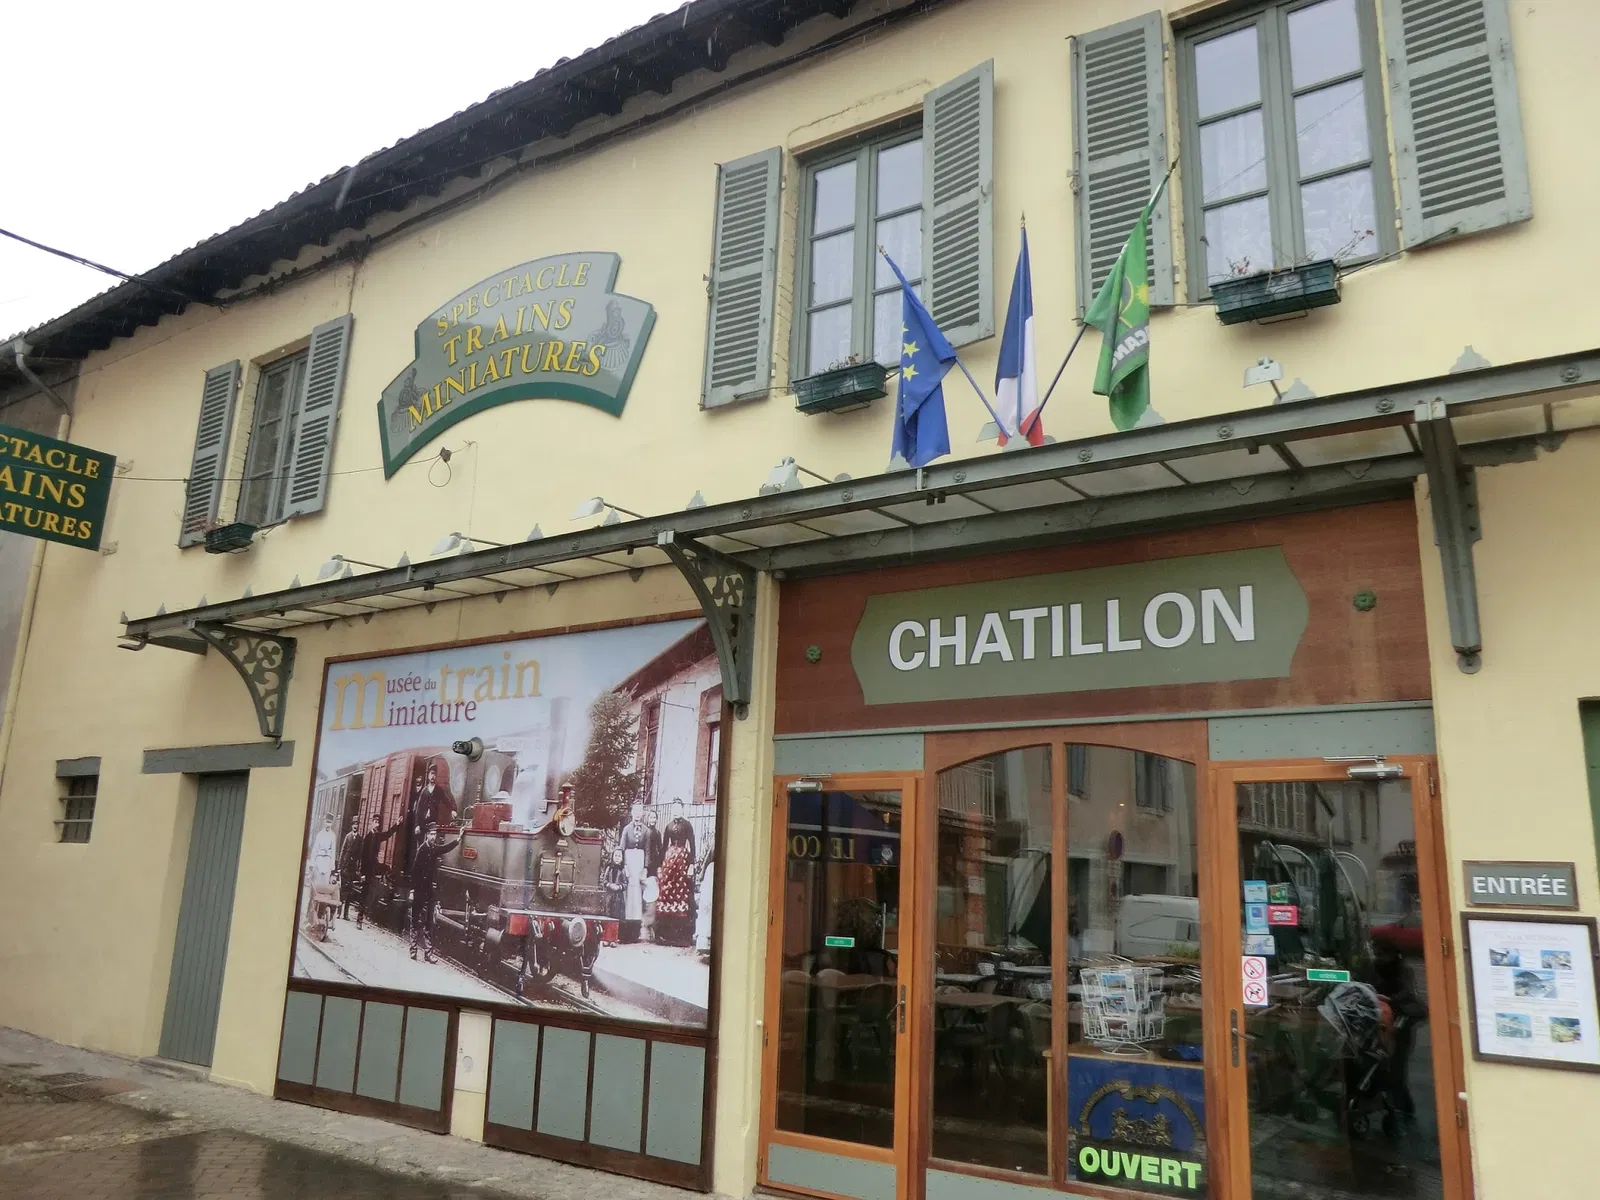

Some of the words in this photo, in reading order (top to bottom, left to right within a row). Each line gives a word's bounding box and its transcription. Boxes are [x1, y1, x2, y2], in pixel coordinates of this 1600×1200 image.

[436, 262, 591, 337] SPECTACLE
[443, 299, 575, 367] TRAINS
[407, 341, 605, 432] MINIATURES
[0, 502, 92, 539] TURES
[888, 585, 1255, 670] CHATILLON
[424, 677, 437, 691] du
[440, 651, 542, 704] train
[1472, 873, 1568, 896] ENTRÉE
[1079, 1146, 1202, 1189] OUVERT
